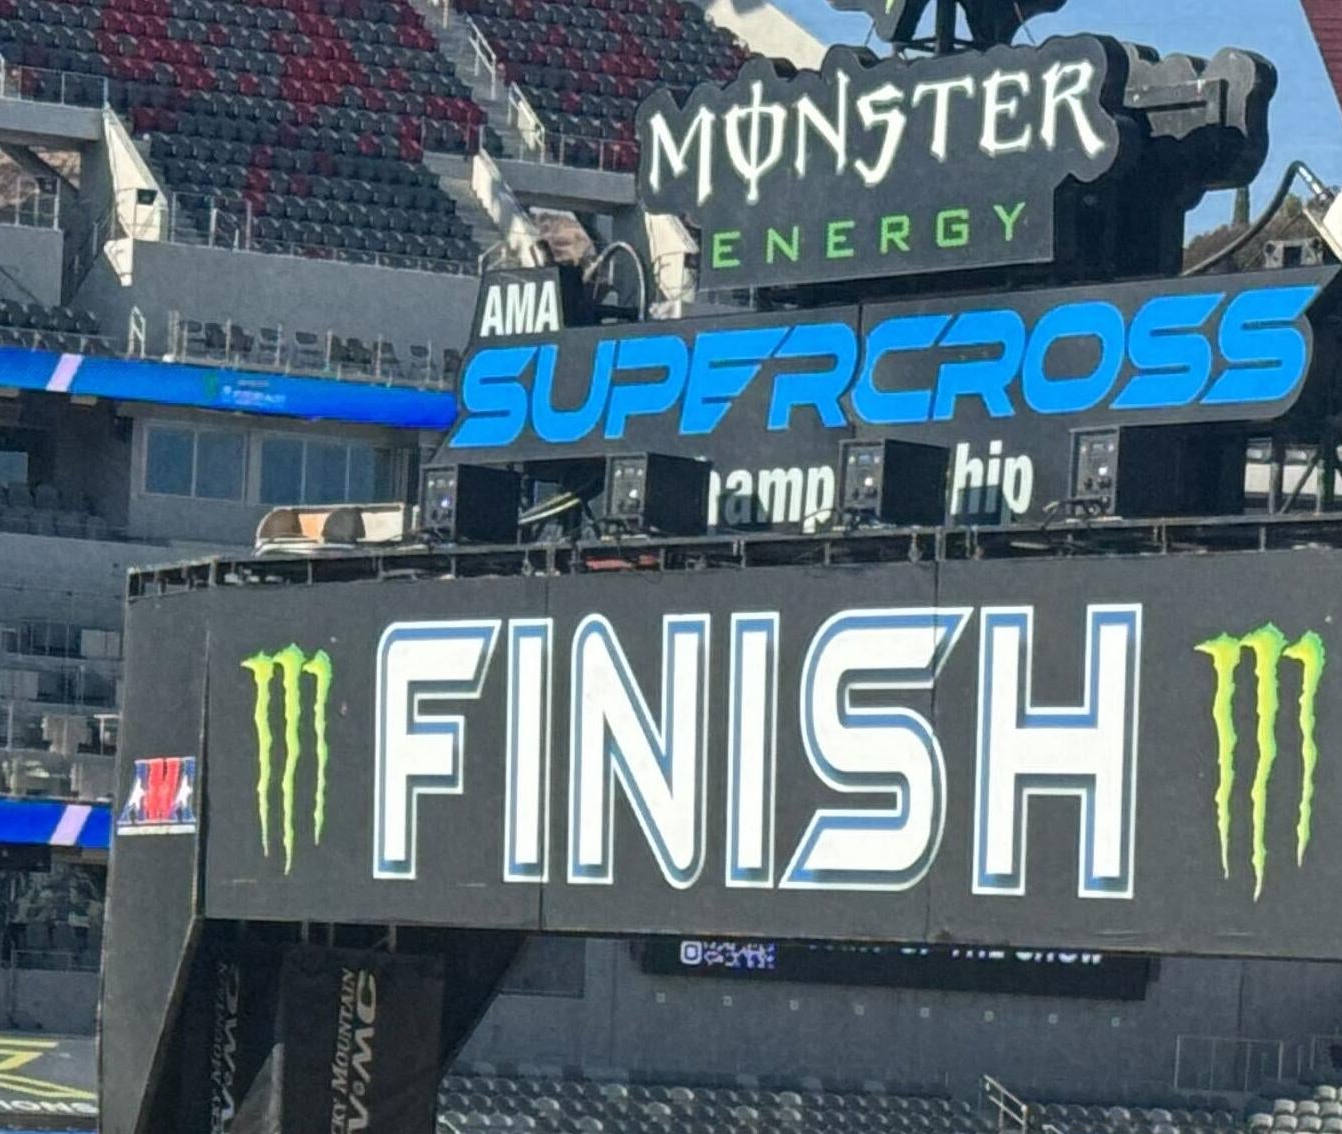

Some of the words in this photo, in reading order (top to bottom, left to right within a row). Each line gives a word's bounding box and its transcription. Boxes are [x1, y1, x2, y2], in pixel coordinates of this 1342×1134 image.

[648, 61, 1106, 205] MONSTER
[710, 201, 1027, 270] ENERGY
[448, 284, 1321, 449] SUPERCROSS
[480, 280, 559, 338] AMA
[372, 604, 1142, 899] FINISH
[331, 967, 357, 1093] MOUNTAIN
